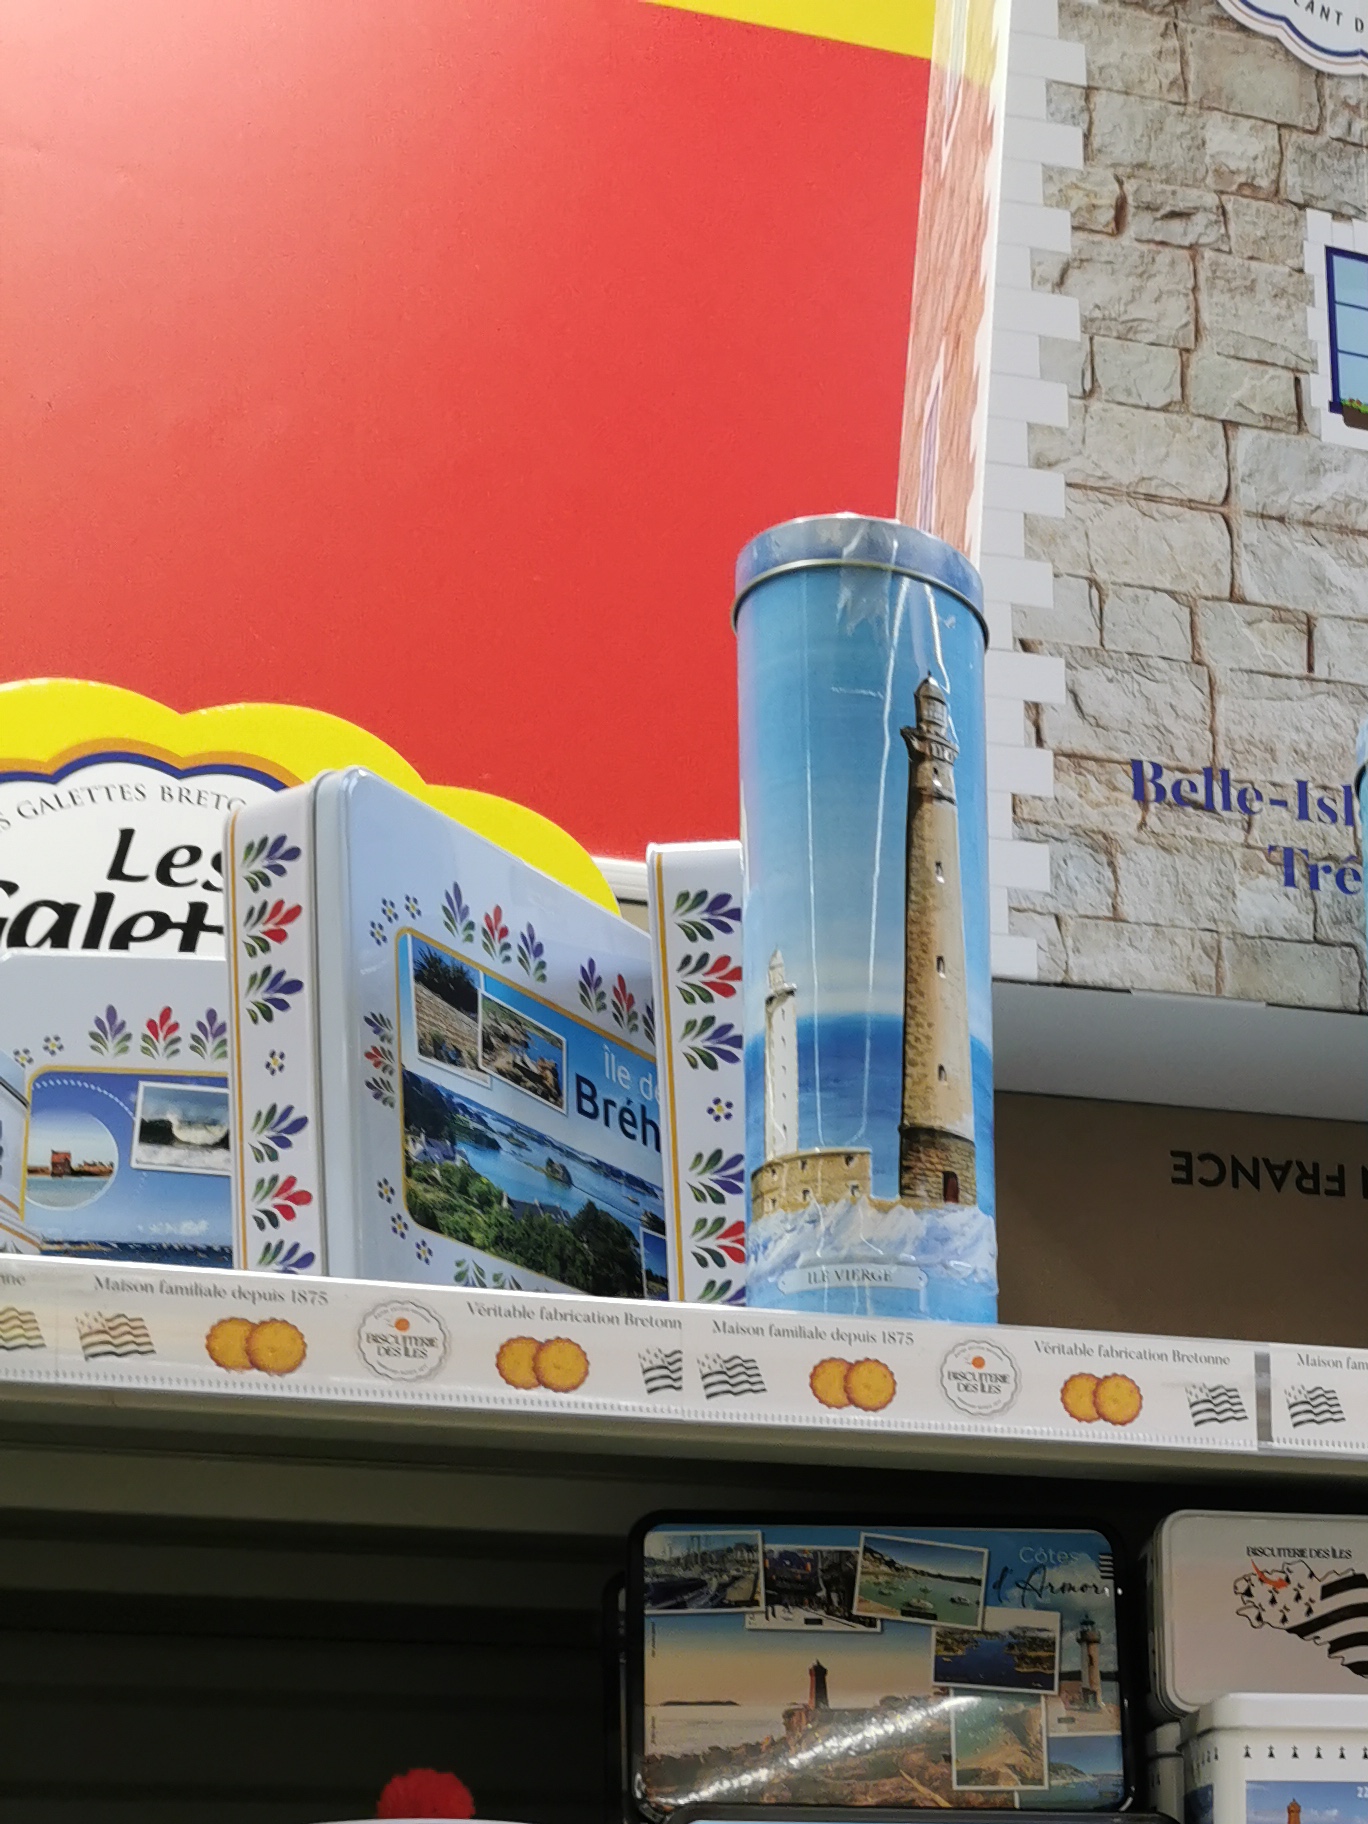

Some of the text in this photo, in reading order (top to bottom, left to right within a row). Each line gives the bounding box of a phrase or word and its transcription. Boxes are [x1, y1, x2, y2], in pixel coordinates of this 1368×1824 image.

[16, 783, 147, 819] GALETTES
[1170, 1149, 1346, 1199] FRANCE
[836, 1268, 893, 1284] VIERGE
[712, 1319, 915, 1347] Maison familiale depuis 1875
[1033, 1340, 1231, 1366] Véritable fabrication Bretonne
[1246, 1546, 1308, 1559] BISCUITERIE
[1308, 1548, 1331, 1559] DES
